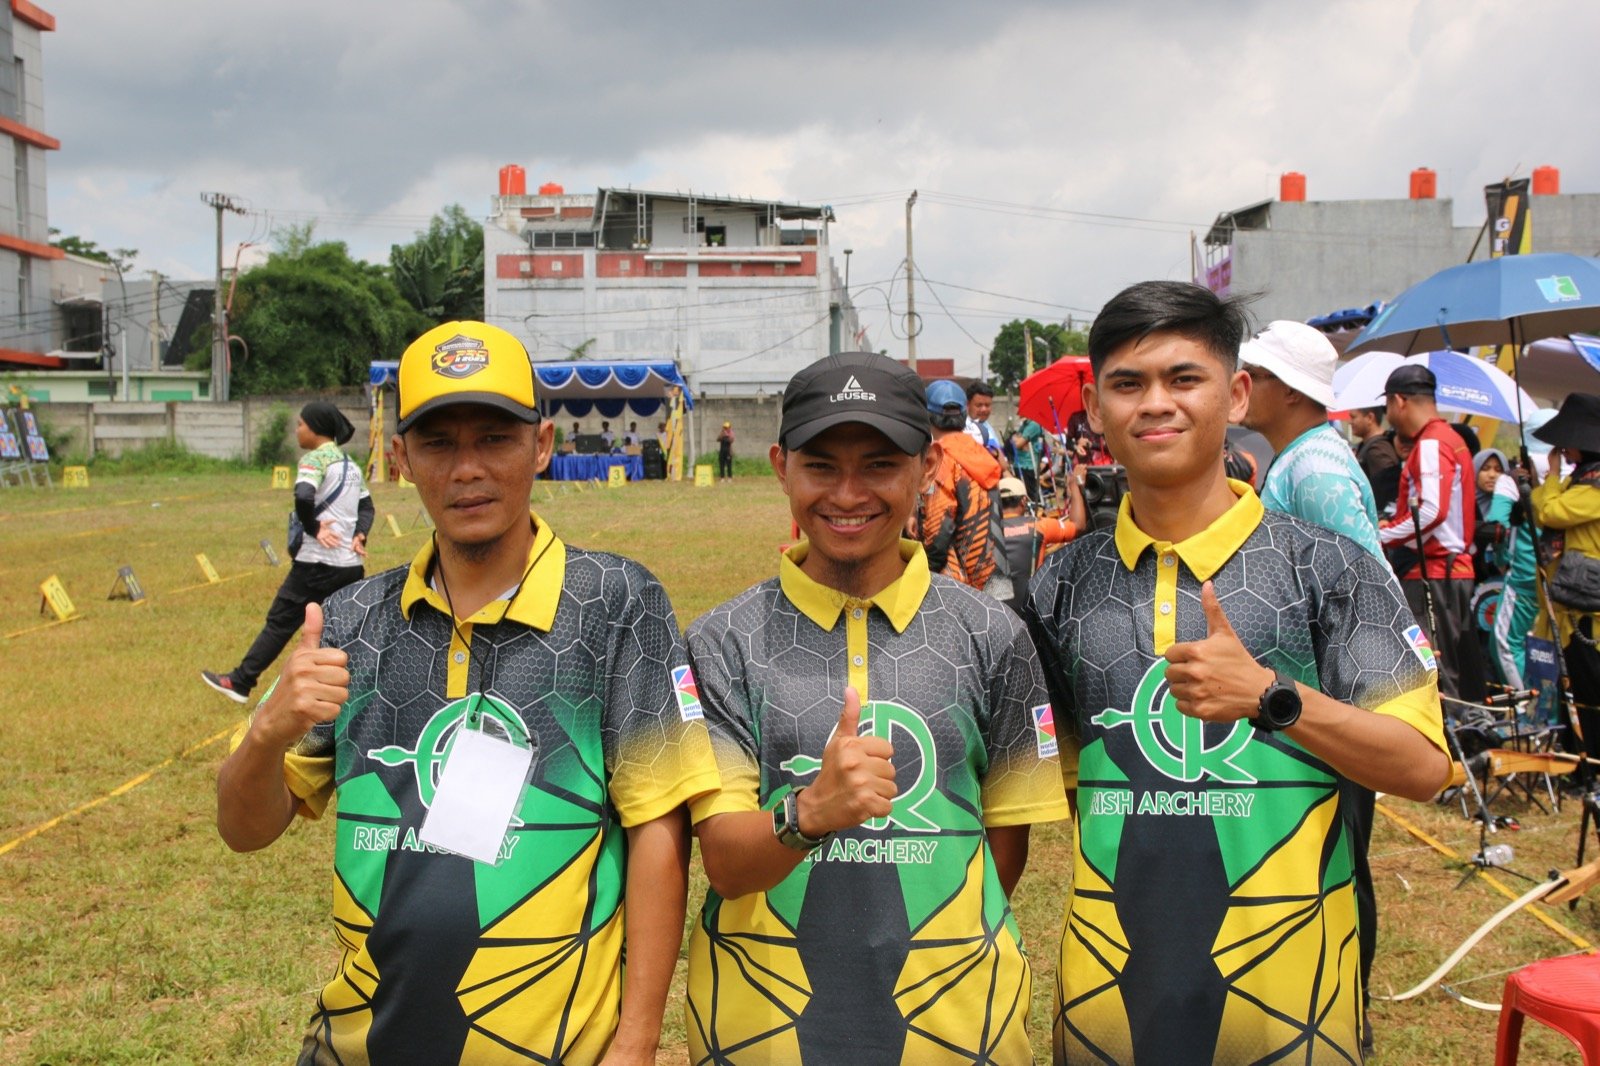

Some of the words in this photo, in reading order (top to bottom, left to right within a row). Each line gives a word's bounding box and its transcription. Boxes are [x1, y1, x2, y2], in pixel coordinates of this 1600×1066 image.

[830, 391, 876, 402] LEUSER
[276, 470, 287, 480] 10
[613, 469, 620, 480] 3
[1137, 791, 1254, 817] ARCHERY
[353, 825, 400, 851] RISH
[827, 837, 938, 863] ARCHERY
